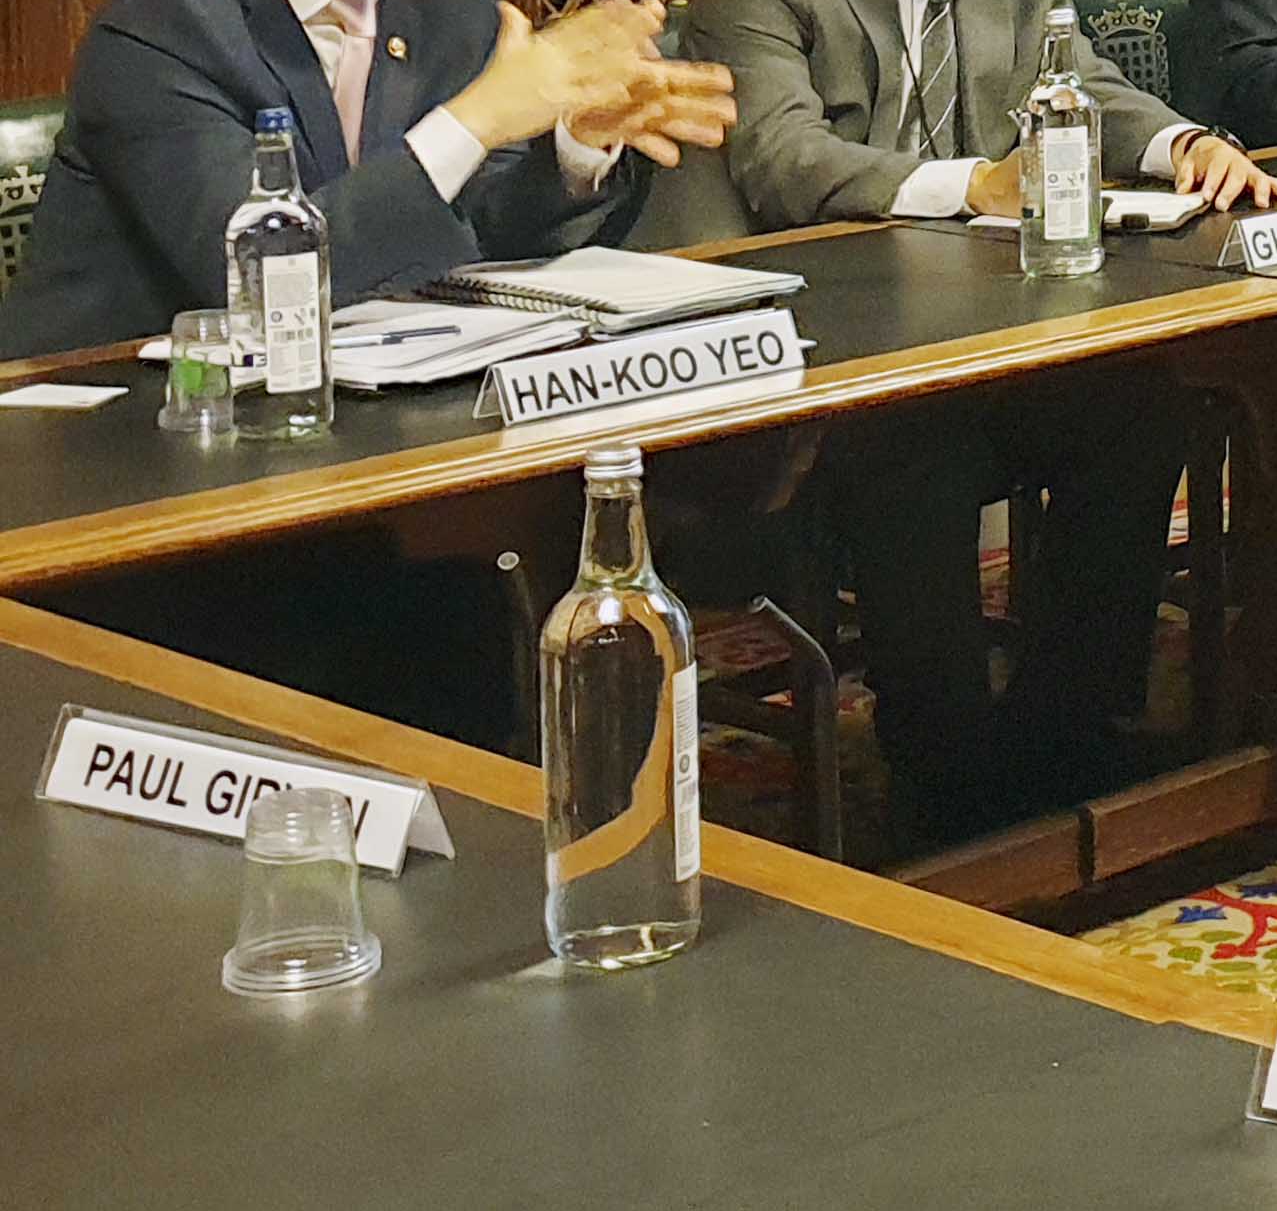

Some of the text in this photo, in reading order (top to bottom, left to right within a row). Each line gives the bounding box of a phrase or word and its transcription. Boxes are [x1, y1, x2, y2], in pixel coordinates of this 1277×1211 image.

[511, 330, 785, 415] HAN-KOO YEO
[84, 743, 371, 836] PAUL GIN
